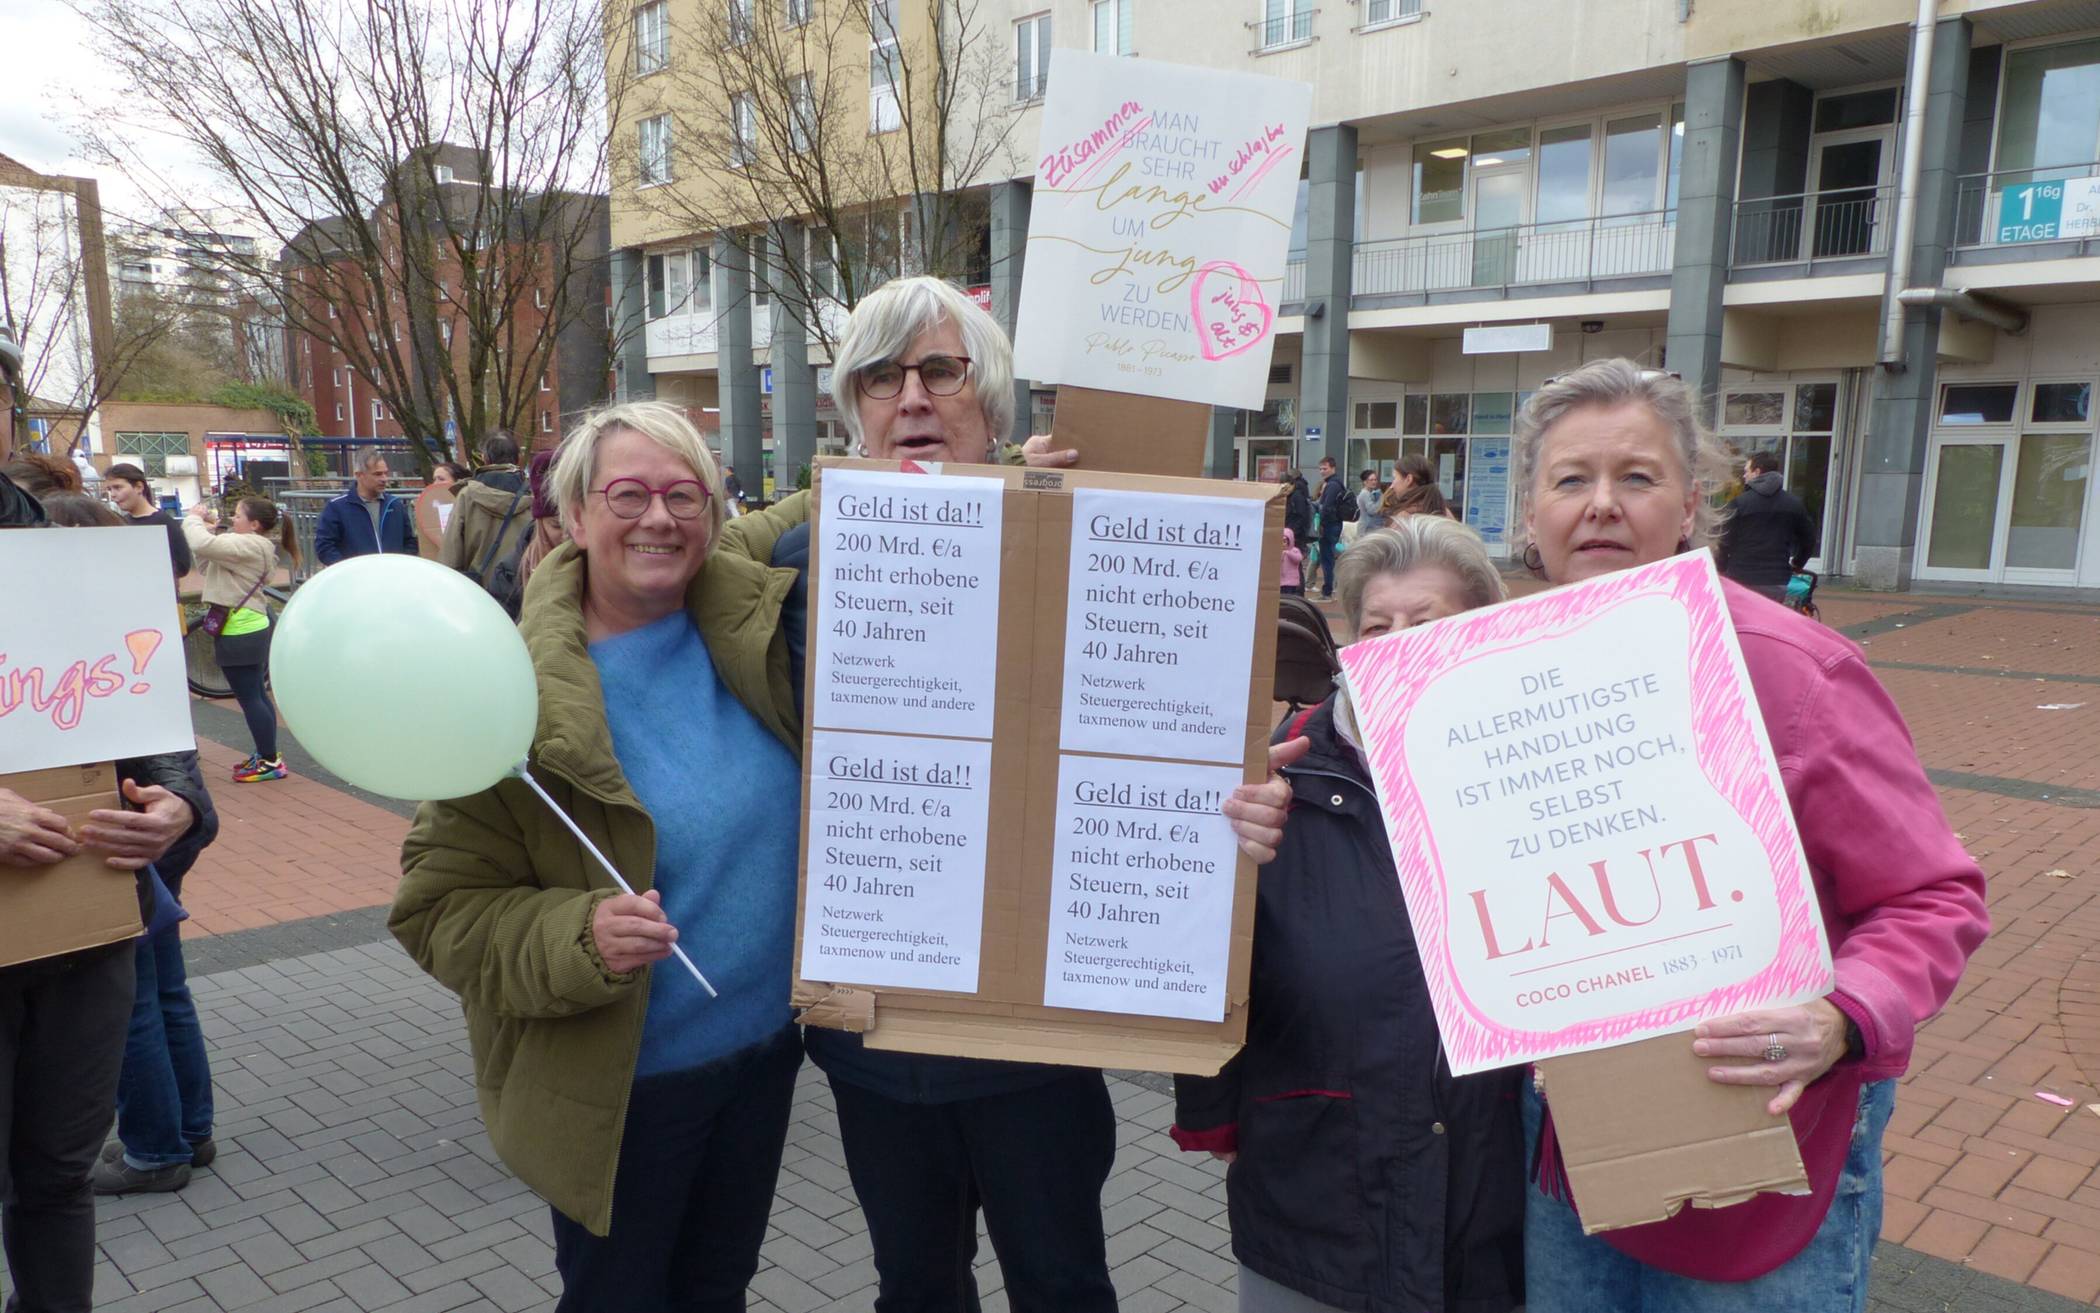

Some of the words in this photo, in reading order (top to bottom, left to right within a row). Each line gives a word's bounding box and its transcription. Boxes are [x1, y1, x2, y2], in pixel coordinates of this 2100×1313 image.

[1150, 110, 1199, 133] MAN
[1122, 130, 1222, 160] BRAUCHT
[1141, 156, 1195, 180] SEHR
[1096, 162, 1207, 229] lange
[2036, 185, 2061, 200] 16g
[1112, 216, 1145, 237] UM
[2001, 222, 2055, 241] ETAGE
[1091, 242, 1197, 293] jung
[1123, 283, 1150, 303] ZU
[838, 495, 892, 519] Geld
[903, 498, 928, 521] ist
[937, 501, 982, 524] da!!
[1090, 515, 1148, 540] Geld
[1158, 519, 1184, 543] ist
[1193, 522, 1241, 547] da!!
[836, 533, 871, 552] 200
[879, 535, 925, 555] Mrd.
[933, 538, 962, 558] €/a
[835, 563, 882, 583] nicht
[890, 565, 979, 589] erhobene
[1088, 553, 1125, 573] 200
[1133, 556, 1180, 579] Mrd.
[1188, 560, 1218, 581] €/a
[834, 591, 913, 616] Steuern,
[920, 597, 954, 616] seit
[1086, 584, 1135, 604] nicht
[1143, 589, 1235, 613] erhobene
[833, 620, 857, 638] 40
[863, 621, 926, 642] Jahren
[1085, 612, 1166, 638] Steuern,
[1173, 620, 1208, 640] seit
[832, 652, 895, 668] Netzwerk
[1082, 641, 1107, 660] 40
[1114, 643, 1178, 666] Jahren
[831, 671, 962, 693] Steuergerechtigkeit,
[1081, 674, 1145, 691] Netzwerk
[1520, 668, 1564, 695] DIE
[831, 692, 898, 706] taxmenow
[903, 694, 927, 708] und
[931, 698, 975, 711] andere
[1080, 693, 1213, 717] Steuergerechtigkeit,
[1447, 673, 1660, 747] ALLERMUTIGSTE
[1078, 714, 1148, 729] taxmenow
[1153, 717, 1177, 732] und
[1181, 721, 1226, 736] andere
[1484, 713, 1636, 768] HANDLUNG
[829, 756, 883, 779] Geld
[893, 759, 918, 782] ist
[927, 763, 971, 785] da!!
[1456, 782, 1492, 808] IST
[1500, 758, 1588, 797] IMMER
[1594, 734, 1686, 773] NOCH,
[827, 792, 862, 809] 200
[870, 794, 914, 816] Mrd.
[922, 799, 951, 818] €/a
[1075, 780, 1131, 805] Geld
[1140, 785, 1167, 808] ist
[1175, 788, 1221, 812] da!!
[1529, 780, 1624, 821] SELBST
[826, 820, 873, 840] nicht
[880, 824, 967, 847] erhobene
[1073, 817, 1109, 836] 200
[1117, 820, 1162, 841] Mrd.
[1170, 824, 1199, 844] €/a
[1506, 834, 1541, 859] ZU
[1549, 805, 1667, 849] DENKEN.
[825, 847, 902, 872] Steuern,
[909, 854, 943, 872] seit
[1071, 847, 1119, 866] nicht
[1126, 851, 1215, 874] erhobene
[824, 874, 847, 893] 40
[853, 876, 914, 898] Jahren
[1070, 873, 1147, 897] Steuern,
[1155, 881, 1189, 900] seit
[1468, 833, 1744, 960] LAUT.
[822, 905, 884, 922] Netzwerk
[1067, 901, 1091, 919] 40
[1098, 903, 1160, 925] Jahren
[821, 924, 948, 947] Steuergerechtigkeit,
[1066, 932, 1128, 949] Netzwerk
[819, 945, 886, 960] taxmenow
[890, 948, 914, 962] und
[918, 952, 961, 966] andere
[1064, 951, 1194, 975] Steuergerechtigkeit,
[1062, 971, 1130, 987] taxmenow
[1135, 975, 1159, 990] und
[1163, 979, 1207, 994] andere
[1516, 983, 1571, 1008] COCO
[1576, 966, 1655, 995] CHANEL
[1663, 954, 1698, 975] 1883
[1710, 944, 1744, 965] 1971
